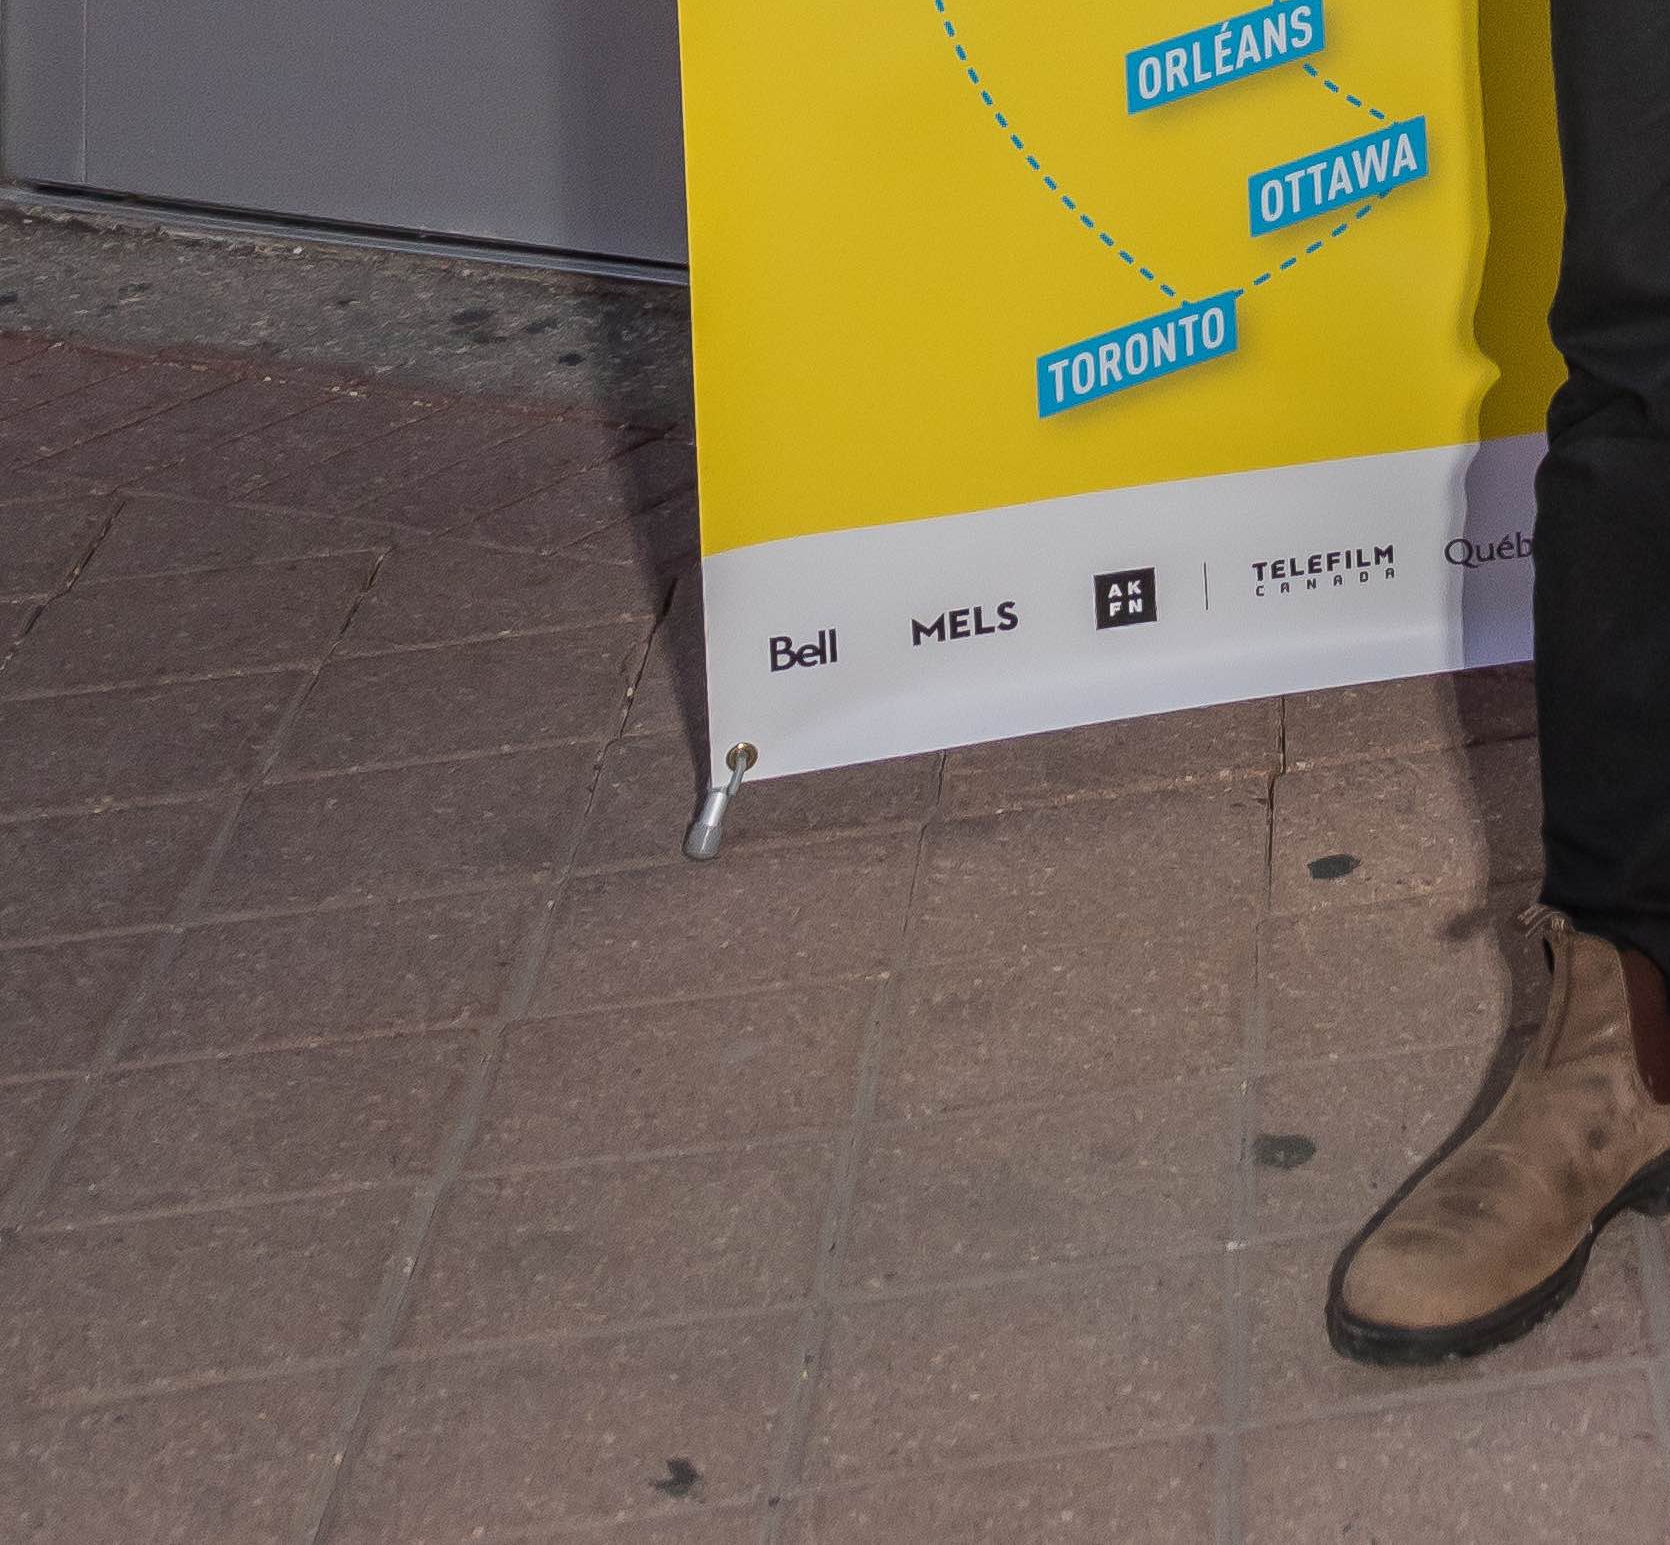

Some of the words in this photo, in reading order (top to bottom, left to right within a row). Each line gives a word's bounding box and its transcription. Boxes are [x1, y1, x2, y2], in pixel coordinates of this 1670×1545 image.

[1139, 6, 1313, 98] ORLÉANS
[1260, 133, 1418, 220] OTTAWA
[1048, 307, 1225, 403] TORONTO
[1252, 545, 1395, 582] TELEFILM
[1444, 531, 1534, 570] Québ
[1255, 567, 1396, 598] CANADA
[911, 600, 1018, 647] MELS
[770, 628, 839, 673] Bell
